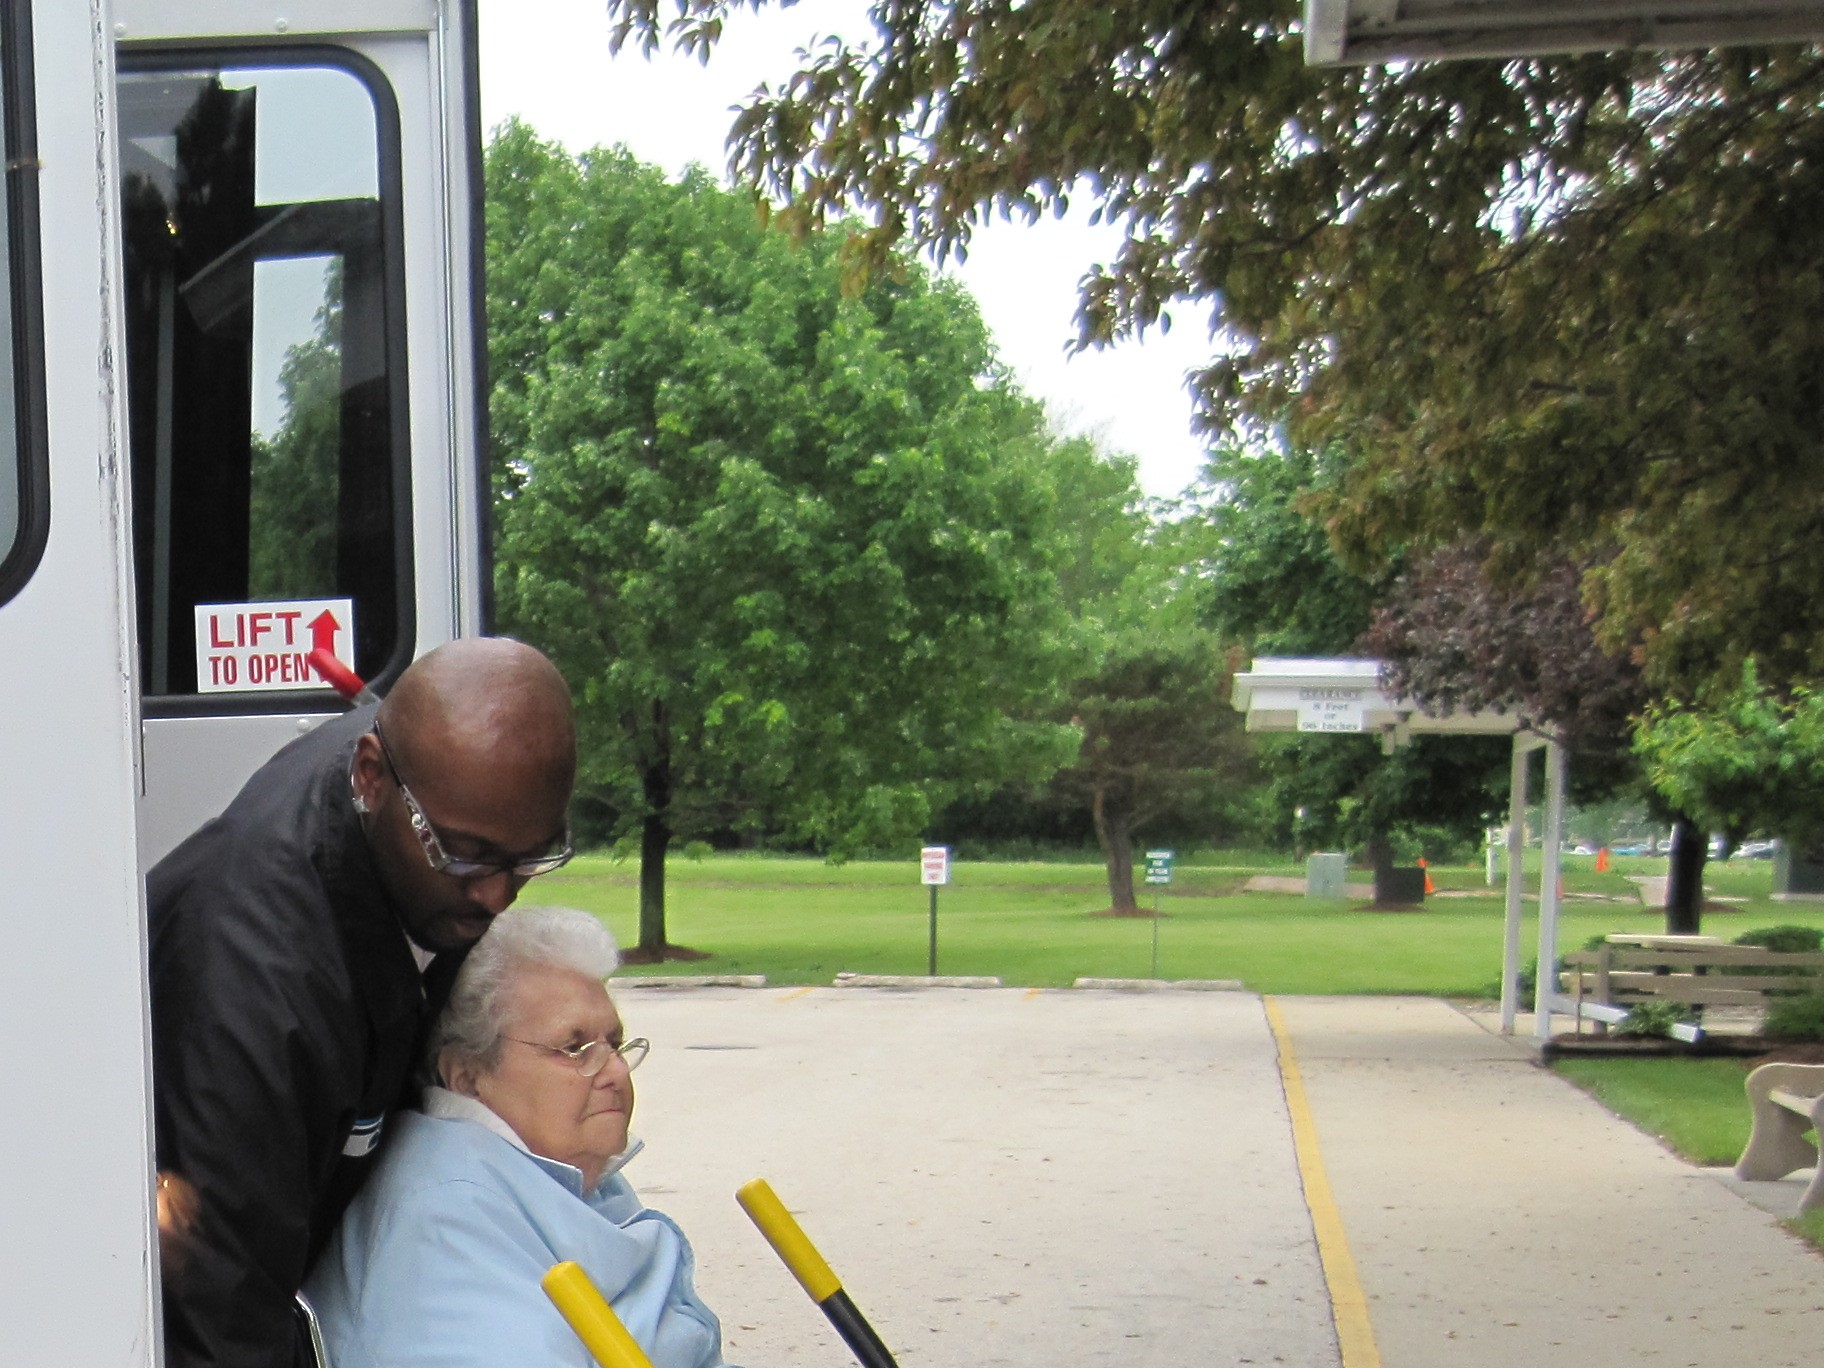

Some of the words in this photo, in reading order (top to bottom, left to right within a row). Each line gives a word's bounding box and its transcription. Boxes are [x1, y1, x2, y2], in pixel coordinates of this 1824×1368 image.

[209, 611, 302, 648] LIFT
[209, 655, 237, 685] TO
[248, 652, 310, 684] OPEN
